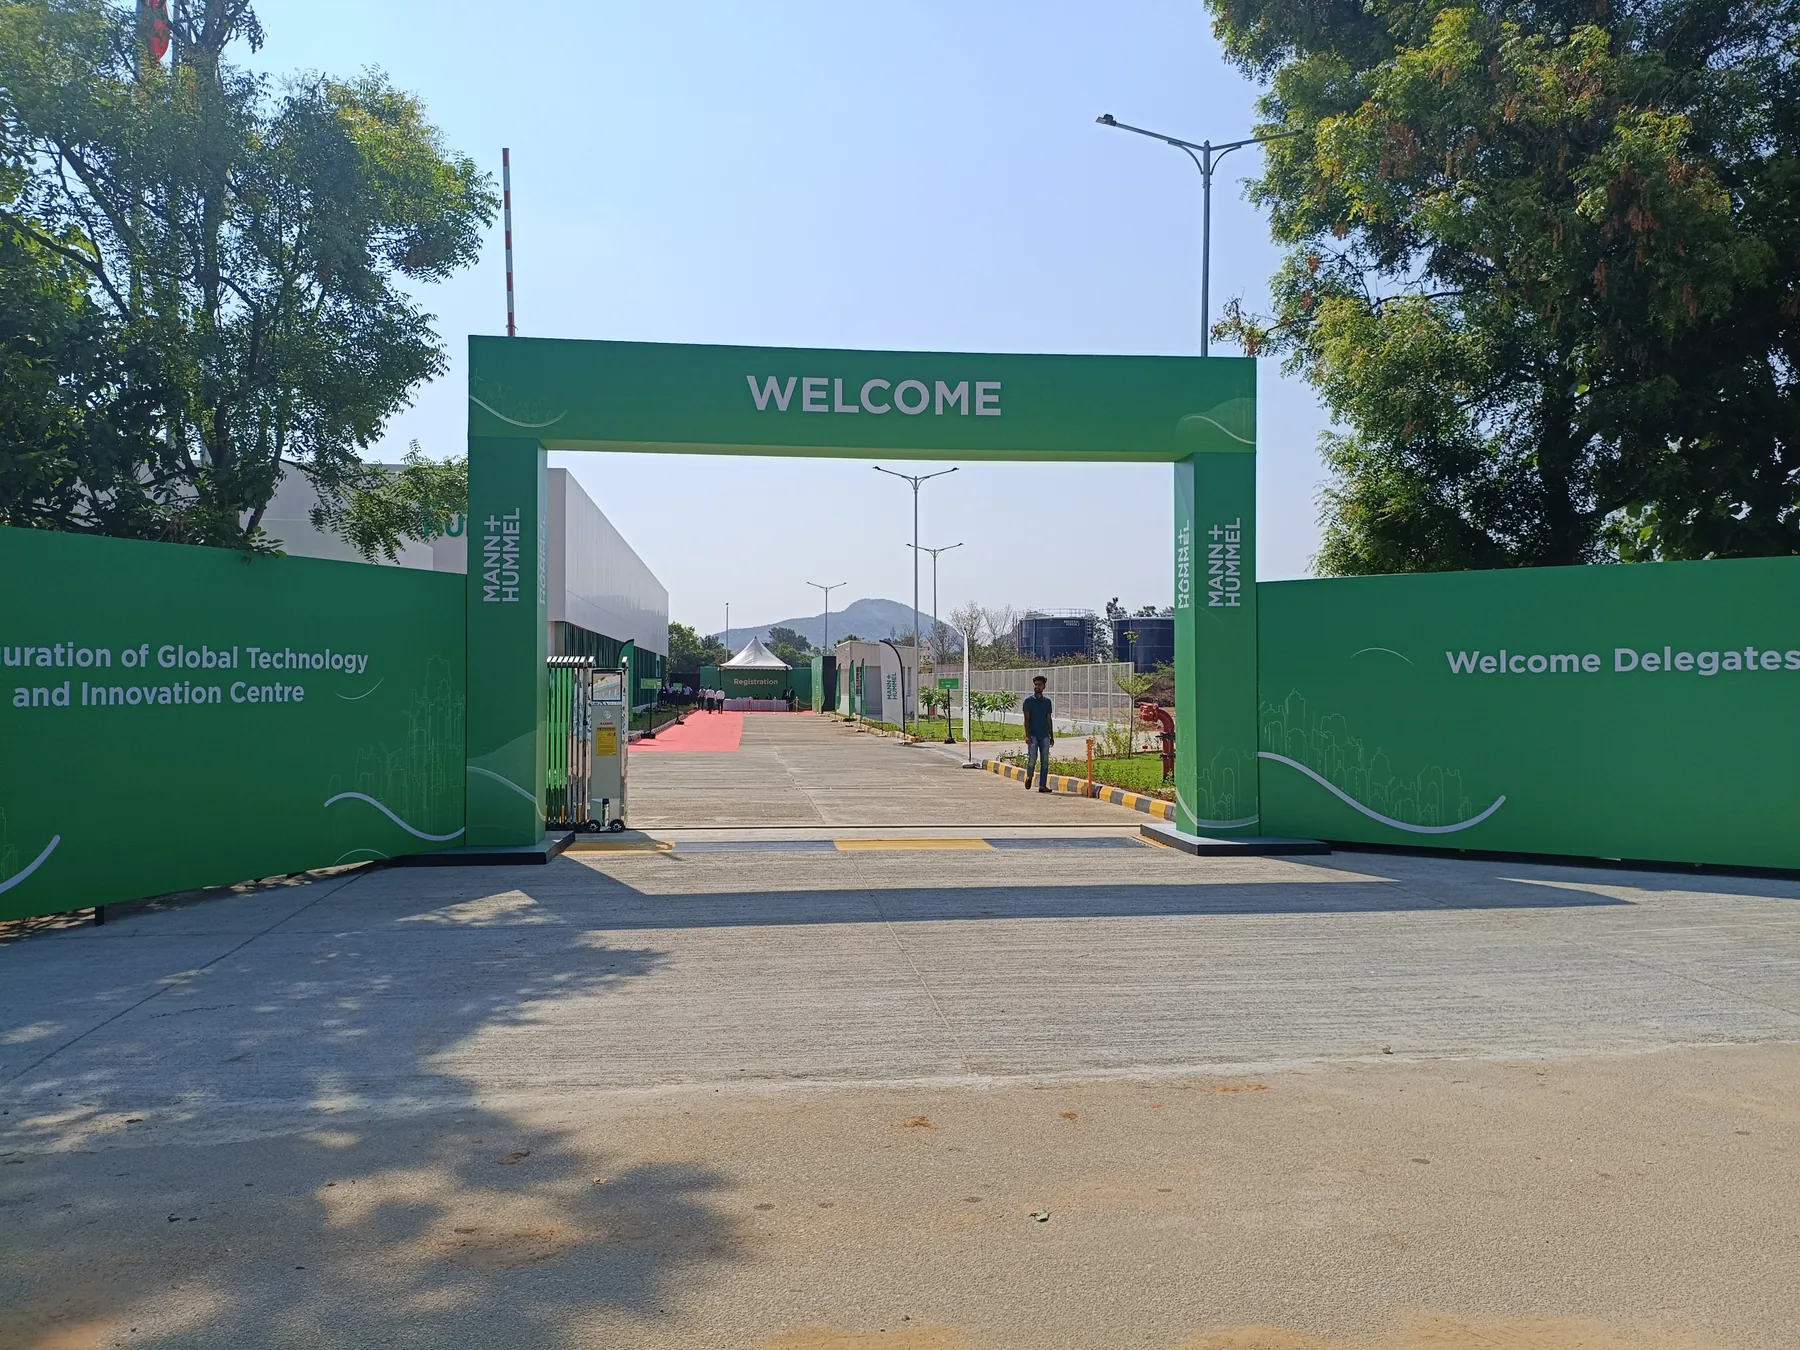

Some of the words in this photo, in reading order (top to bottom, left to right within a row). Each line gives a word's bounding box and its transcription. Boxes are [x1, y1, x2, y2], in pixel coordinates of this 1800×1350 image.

[746, 375, 1001, 416] WELCOME
[483, 514, 501, 602] MANN+
[502, 507, 520, 602] HUMMEL
[1208, 524, 1224, 607] MANN+
[1225, 517, 1241, 607] HUMMEL
[0, 642, 112, 668] uration
[121, 643, 150, 668] of
[157, 644, 239, 669] Global
[246, 647, 369, 674] Technology
[1446, 649, 1601, 674] Welcome
[1614, 646, 1800, 676] Delegates
[13, 681, 70, 707] and
[81, 680, 222, 706] Innovation
[230, 681, 305, 704] Centre
[733, 678, 779, 686] Registration
